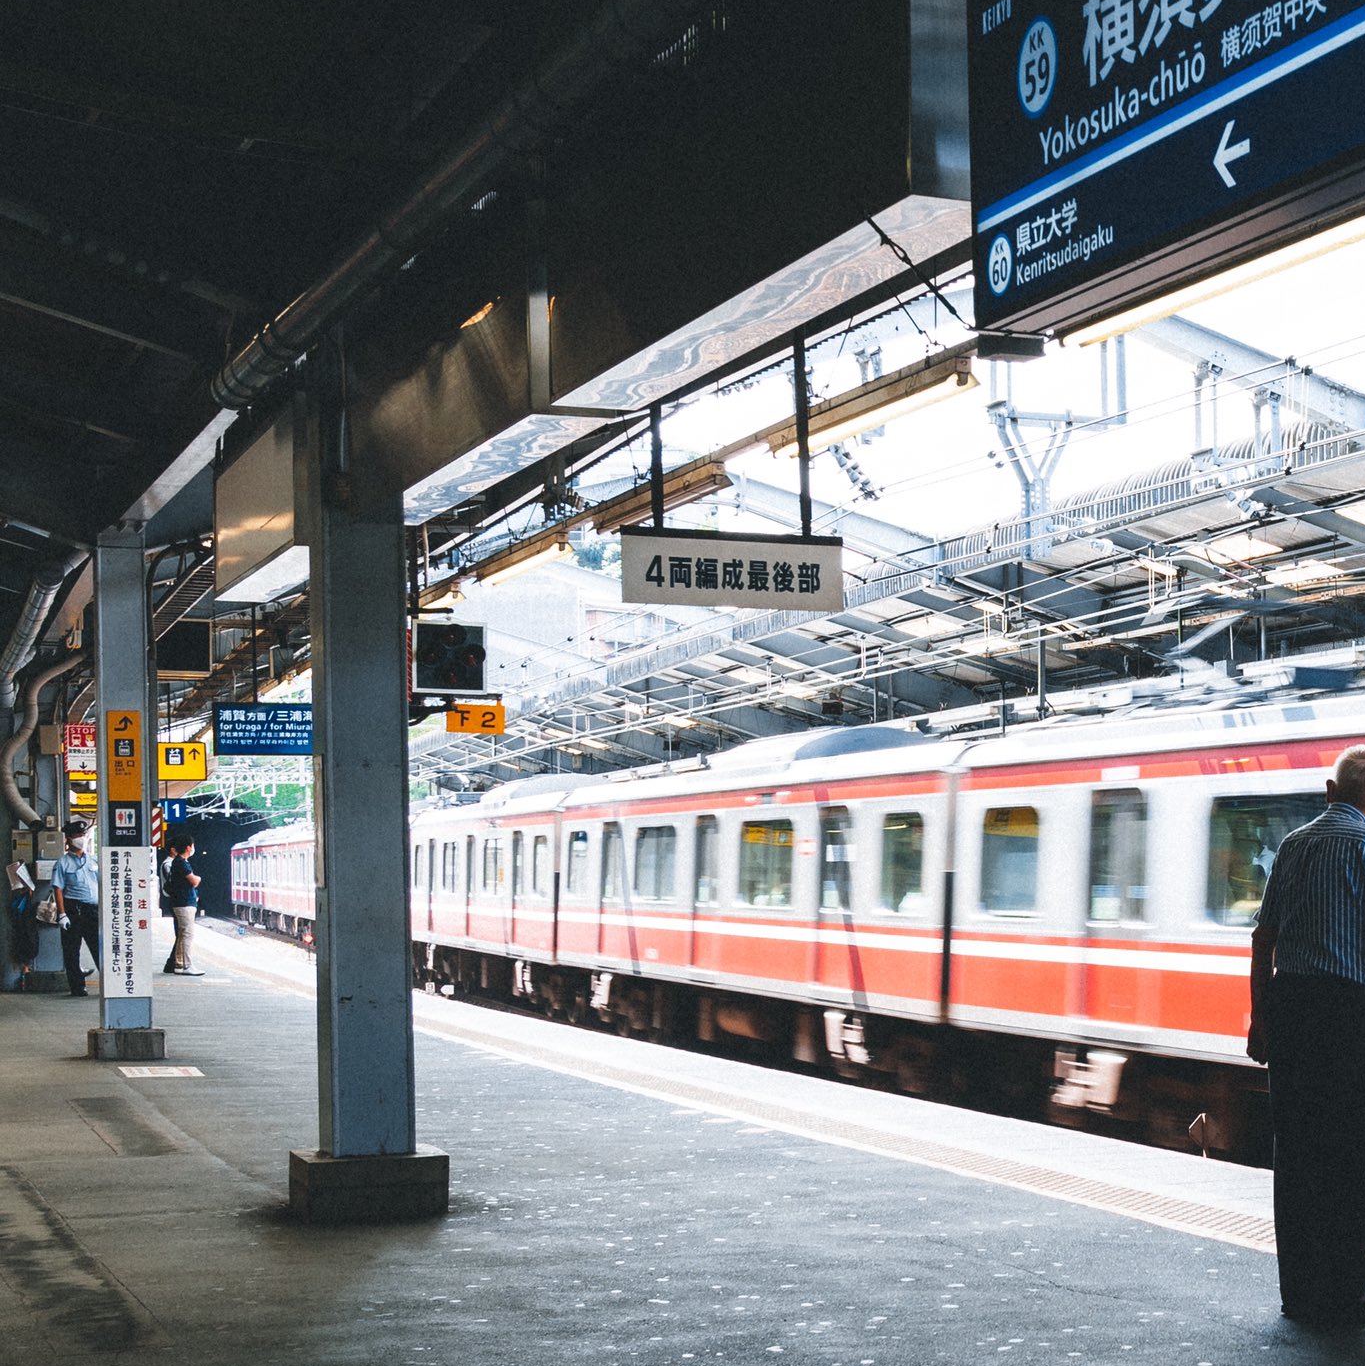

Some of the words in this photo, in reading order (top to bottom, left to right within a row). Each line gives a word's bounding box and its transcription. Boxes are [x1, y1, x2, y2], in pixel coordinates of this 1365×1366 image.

[1028, 27, 1045, 54] KK
[1024, 55, 1050, 103] 59
[1040, 41, 1206, 165] Yokosuka-chūō
[1016, 197, 1078, 257] 県立大学
[992, 256, 1008, 286] 60
[1016, 224, 1114, 286] Kenritsudaigaku
[645, 554, 821, 594] 4両編成最後部
[235, 723, 261, 731] Uraga
